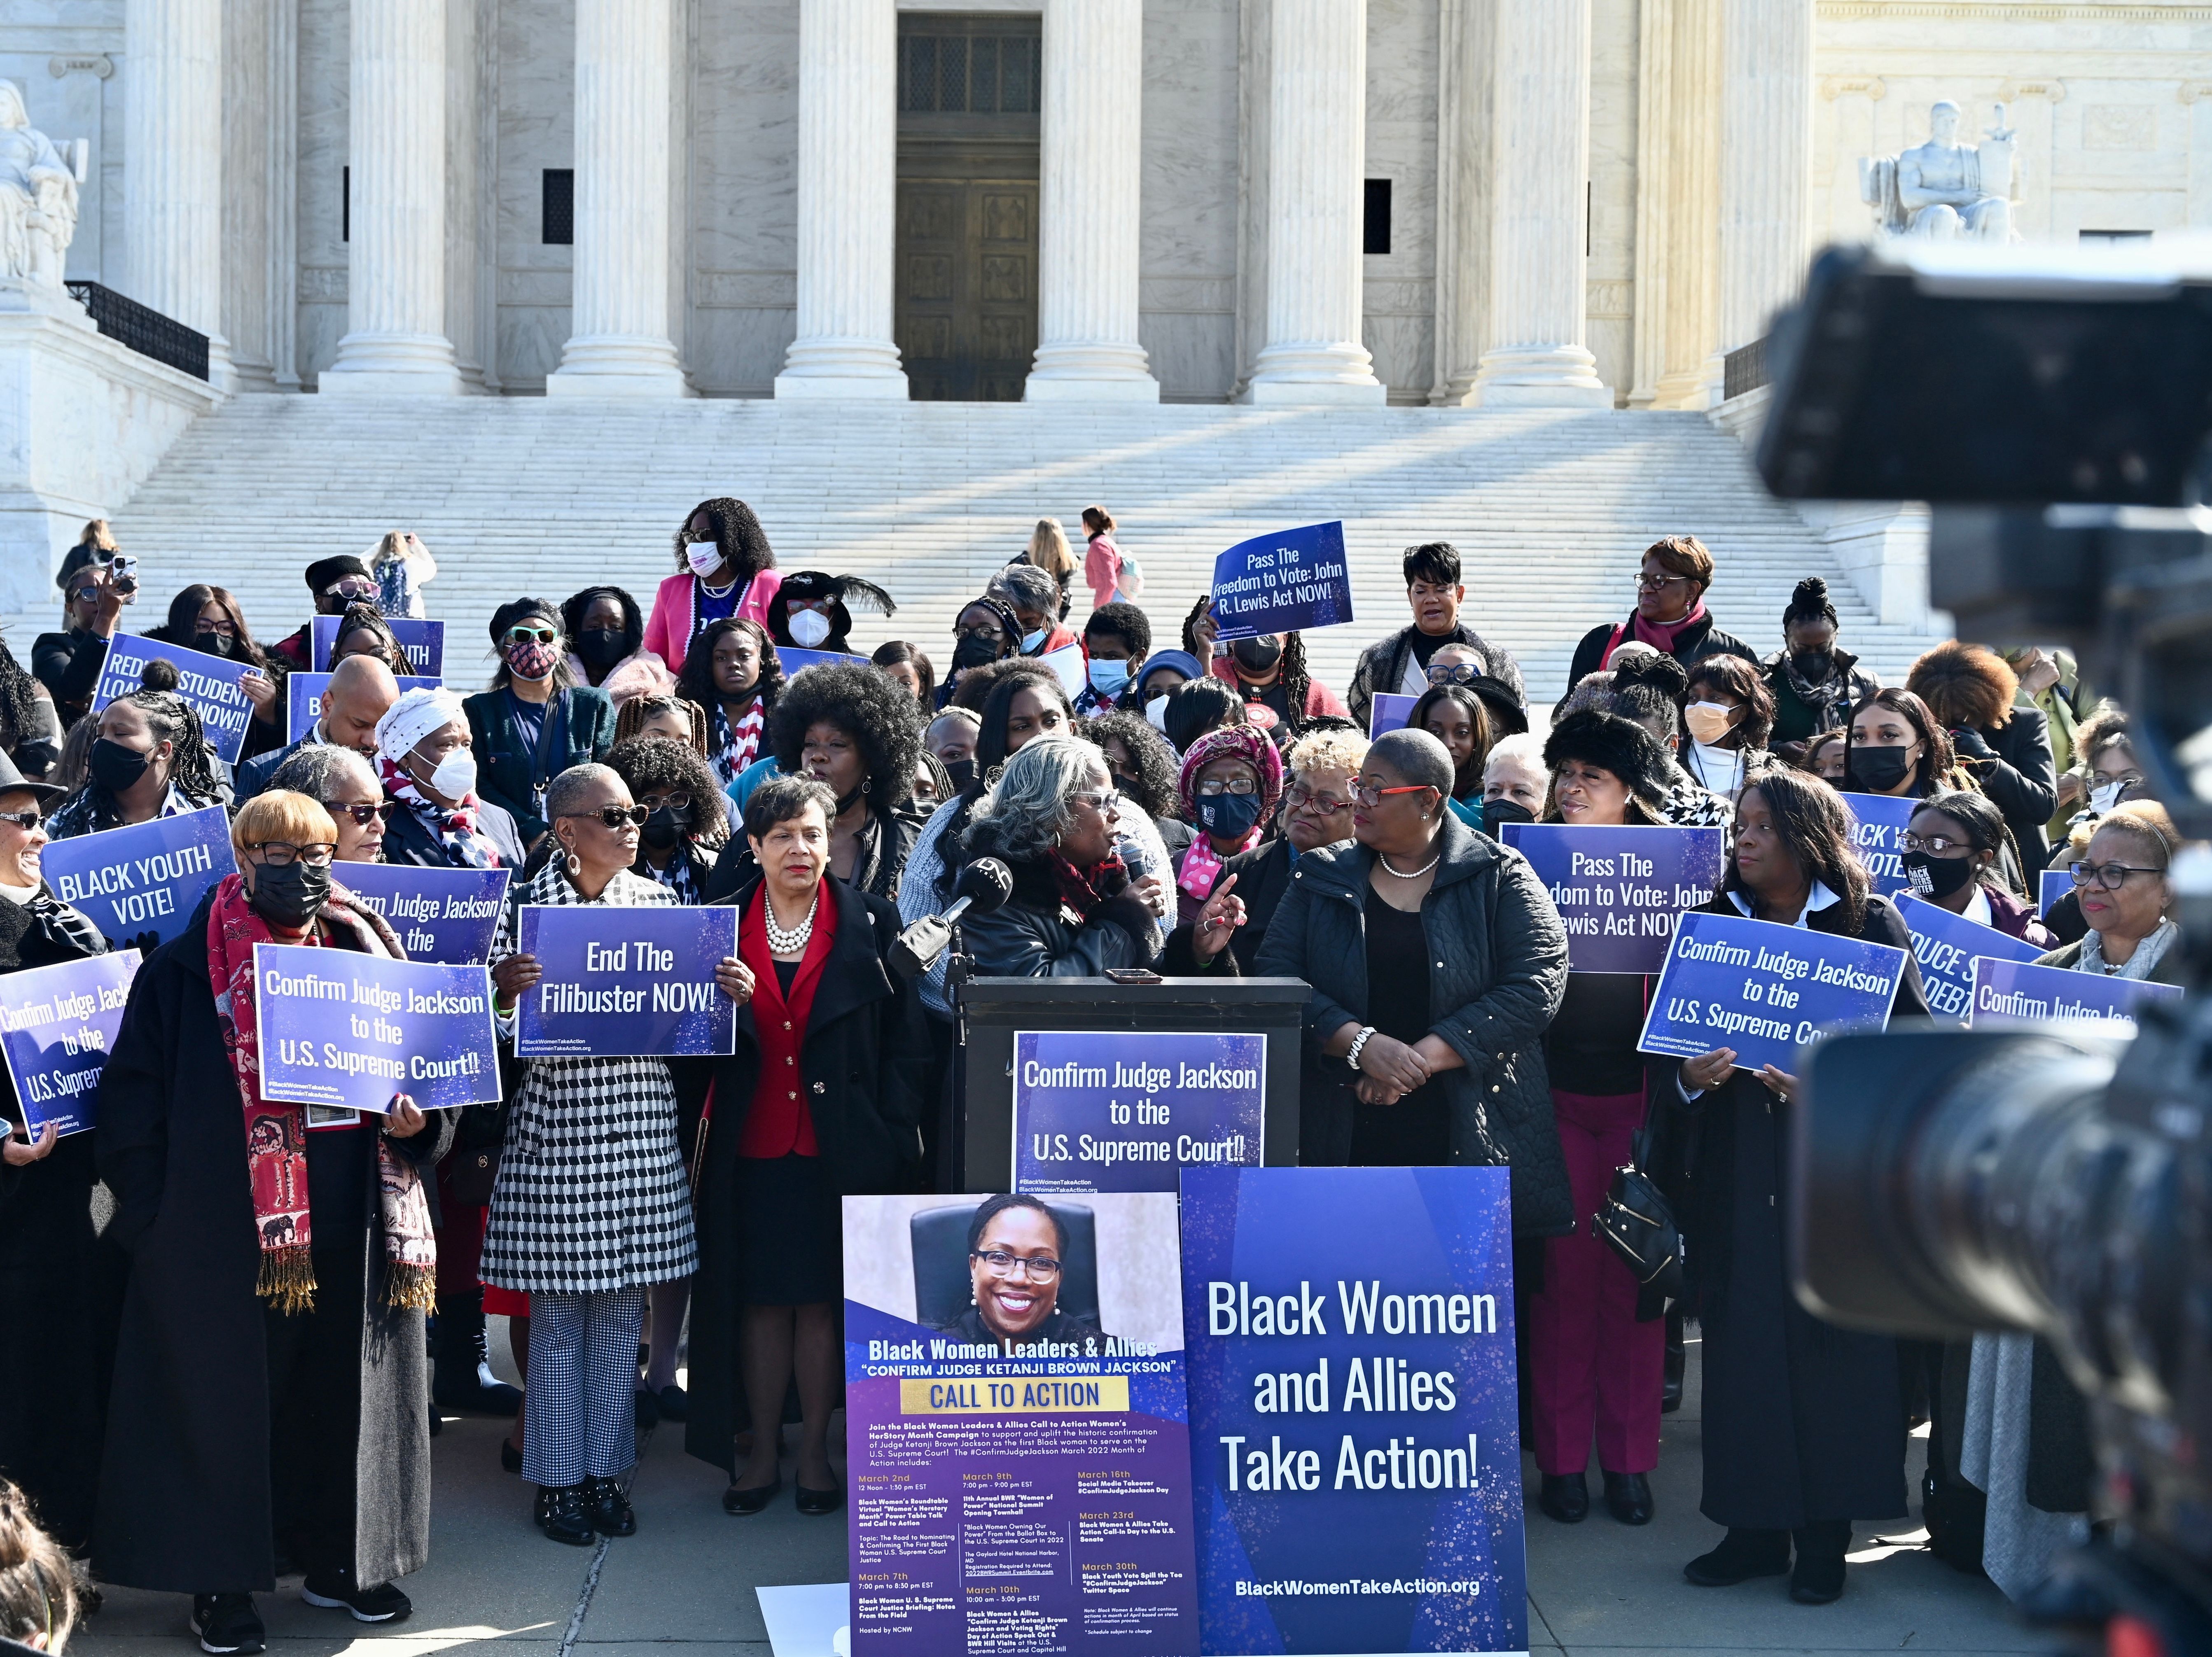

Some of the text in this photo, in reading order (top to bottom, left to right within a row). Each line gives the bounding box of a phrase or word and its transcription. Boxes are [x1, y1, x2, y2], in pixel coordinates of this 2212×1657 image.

[1248, 548, 1299, 570] Pass The
[1263, 572, 1276, 587] to
[1279, 567, 1311, 585] Vote:
[1315, 562, 1342, 580] John
[1218, 582, 1331, 615] R. Lewis Act NOW!
[178, 670, 248, 707] STUDENT
[196, 701, 245, 733] NOW!!
[1847, 823, 1890, 847] ACK
[59, 844, 212, 902] BLACK YOUTH
[980, 870, 1001, 888] TRUTH
[1572, 852, 1652, 877] Pass The
[111, 887, 175, 924] VOTE!
[389, 892, 439, 922] Judge
[442, 895, 498, 919] Jackson
[1595, 884, 1614, 906] to
[1620, 883, 1667, 907] Vote:
[1562, 913, 1599, 935] ewis
[1604, 912, 1635, 936] Act
[407, 927, 434, 952] the
[587, 942, 673, 971] End The
[1678, 936, 1890, 995] Confirm Judge Jackson
[266, 971, 484, 1014] Confirm Judge Jackson
[542, 983, 715, 1013] Filibuster NOW!
[1743, 978, 1799, 1009] to the
[1979, 985, 2048, 1020] Confirm
[0, 1001, 54, 1032] Confirm
[54, 991, 96, 1021] Judge
[1668, 998, 1700, 1024] U.S.
[1706, 1004, 1791, 1040] Supreme
[61, 1025, 104, 1056] to the
[350, 1014, 402, 1045] to the
[1647, 1034, 1710, 1048] #BlackWomenTakeAction
[280, 1039, 481, 1079] U.S. Supreme Court!!
[26, 1074, 56, 1102] U.S.
[268, 1081, 338, 1092] #BlackWomenTakeAction
[1025, 1061, 1256, 1093] Confirm Judge Jackson
[269, 1088, 344, 1102] BlackWomenTakeAction.org
[1110, 1098, 1170, 1125] to the
[1034, 1134, 1245, 1166] U.S. Supreme Court!!
[1209, 1281, 1496, 1335] Black Women
[869, 1336, 1157, 1360] Black Women Leaders & Allies
[862, 1360, 1176, 1376] “CONFIRM JUDGE KETANJI BROWN JACKSON”
[931, 1383, 1098, 1408] CALL TO ACTION
[1254, 1357, 1456, 1413] and Allies
[1220, 1434, 1479, 1491] Take Action!
[1236, 1578, 1479, 1596] BlackWomenTakeAction.org
